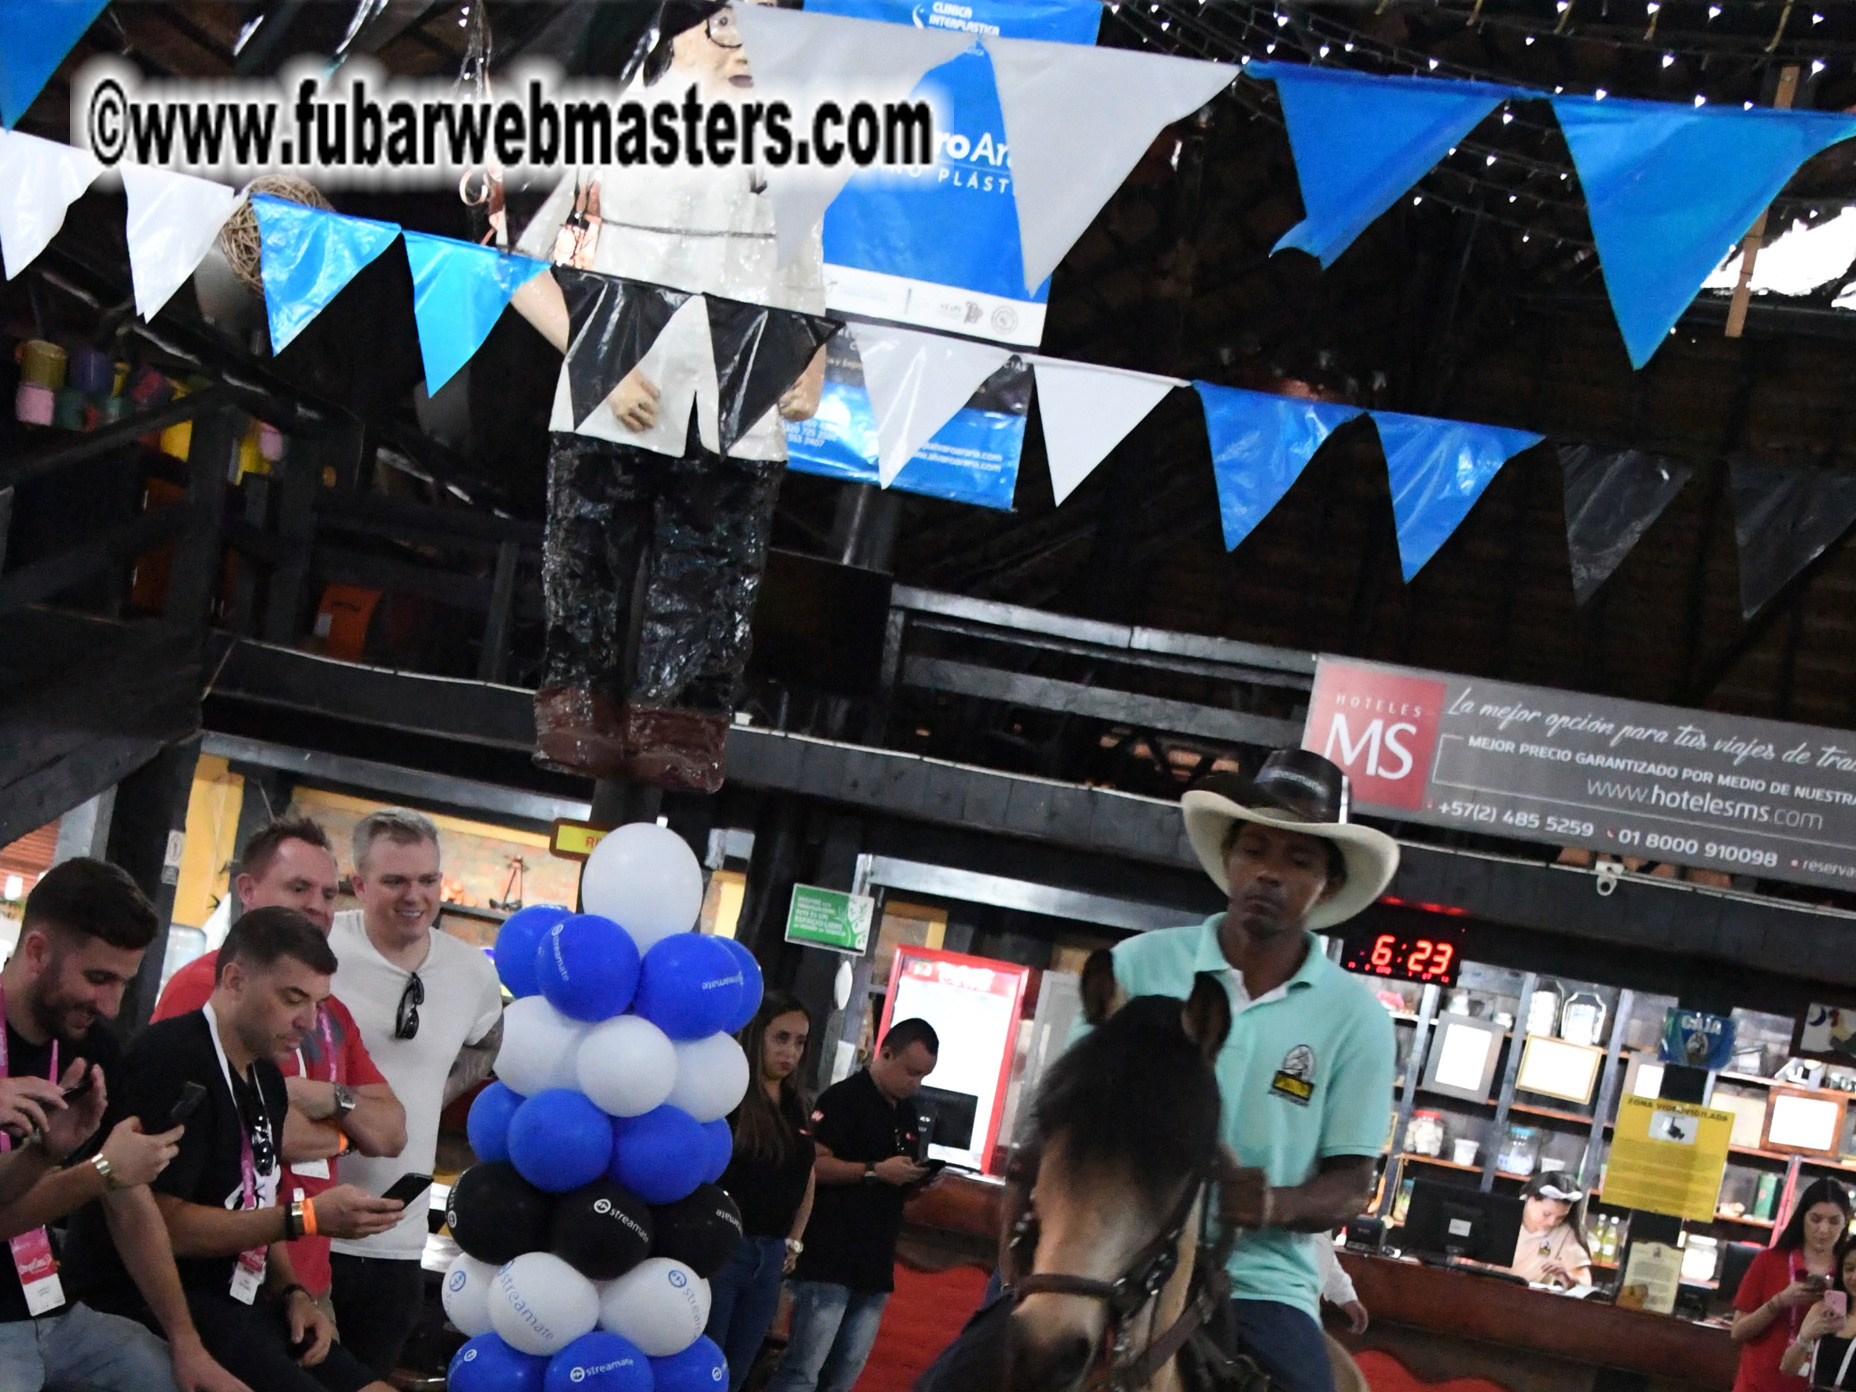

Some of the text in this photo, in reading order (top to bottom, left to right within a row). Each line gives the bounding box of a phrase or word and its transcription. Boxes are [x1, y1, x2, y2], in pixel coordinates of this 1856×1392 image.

[929, 14, 1000, 37] INTERPLASTICA
[932, 1, 973, 19] CLINICA
[938, 168, 1010, 194] PLÁST
[1336, 694, 1422, 718] HOTELES
[1323, 713, 1417, 780] MS
[1449, 687, 1474, 715] La
[1479, 703, 1542, 731] mejor
[1545, 711, 1614, 738] opción
[1610, 724, 1669, 748] para
[1673, 724, 1708, 750] tus
[1712, 736, 1776, 767] viajes
[1781, 742, 1812, 765] de
[1468, 735, 1515, 754] MEJOR
[1519, 743, 1572, 762] PRECIO
[1575, 752, 1679, 779] GARANTIZADO
[1681, 767, 1714, 784] POR
[1717, 774, 1767, 793] MEDIO
[1769, 782, 1791, 796] DE
[1586, 779, 1824, 831] www.hotelesms.com
[1438, 800, 1856, 878] +57(2) 485 5259 01 8000 910098 reserva
[1371, 934, 1454, 975] 6:23
[1681, 1014, 1723, 1036] CAJA
[609, 1207, 650, 1244] streamate
[499, 1272, 554, 1341] streamate
[585, 1357, 635, 1377] streamate
